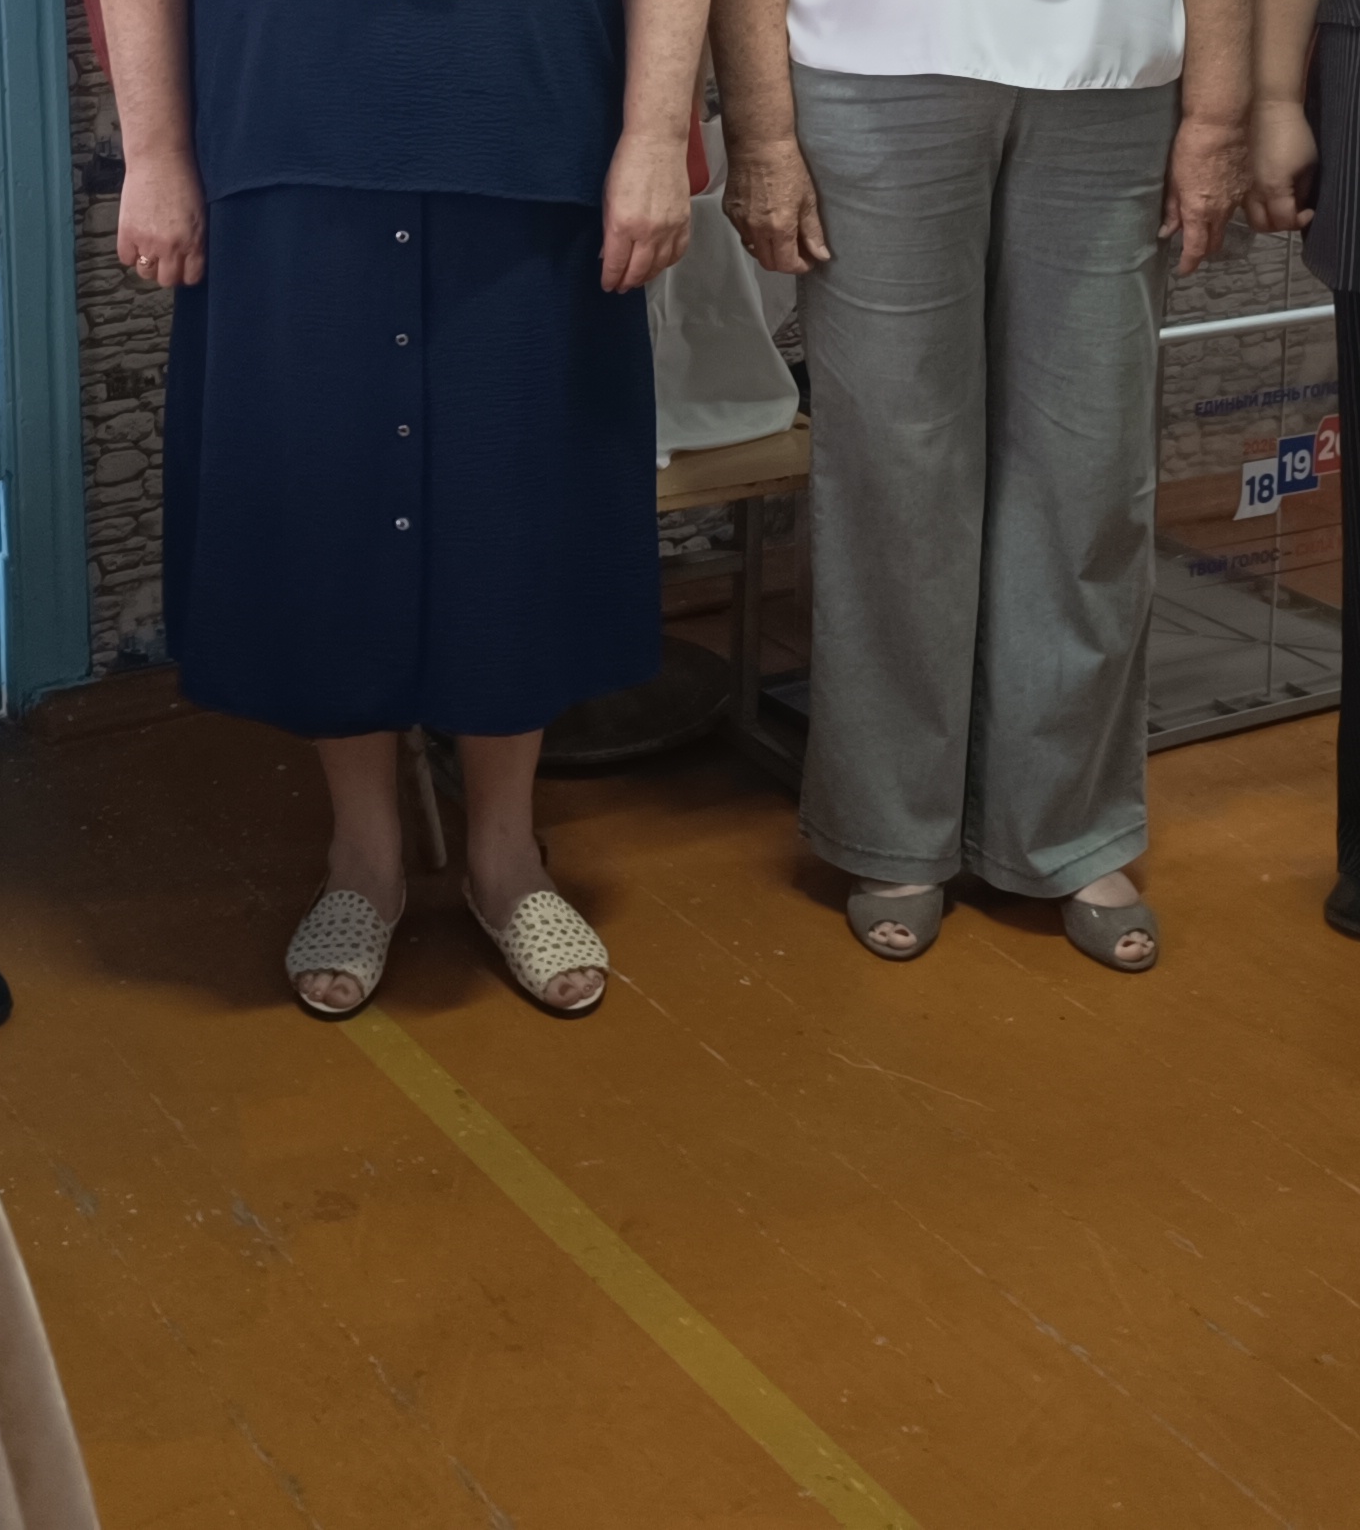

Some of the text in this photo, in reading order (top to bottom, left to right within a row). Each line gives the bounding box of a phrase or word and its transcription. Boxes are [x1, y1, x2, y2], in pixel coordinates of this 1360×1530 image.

[1195, 392, 1259, 416] ЕДИНЫЙ
[1261, 388, 1301, 406] ДЕНЬ
[1282, 449, 1311, 482] 19
[1245, 473, 1274, 506] 18
[1230, 547, 1281, 569] ГОЛОС
